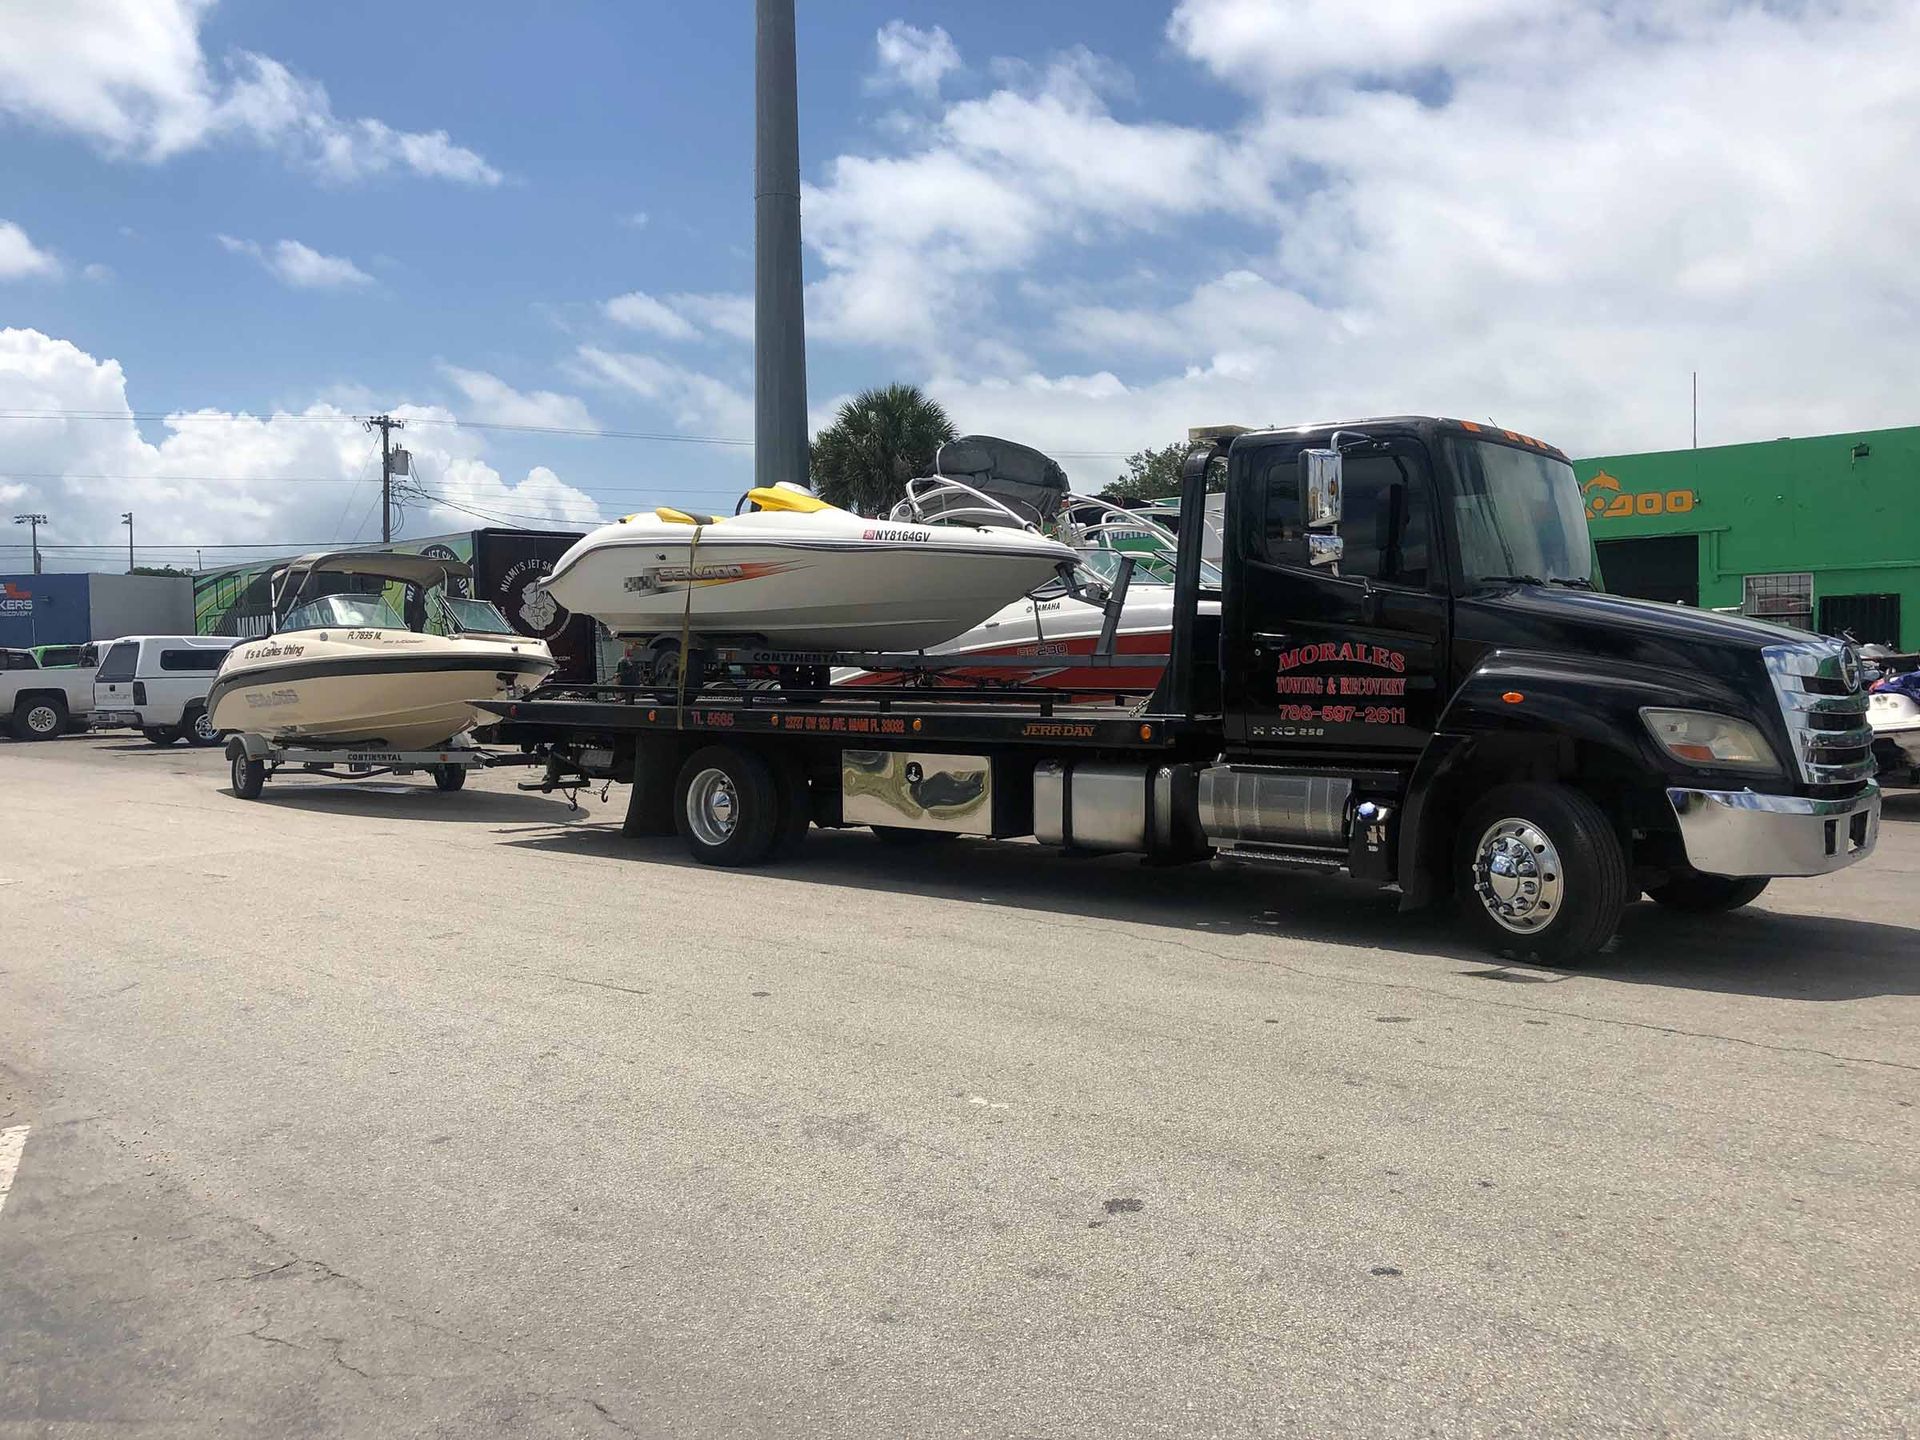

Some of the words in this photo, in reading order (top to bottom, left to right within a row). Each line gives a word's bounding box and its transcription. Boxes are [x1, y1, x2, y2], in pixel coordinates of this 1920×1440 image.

[876, 530, 931, 542] NY8164GV
[527, 559, 540, 569] JET
[542, 561, 553, 572] SK
[1034, 602, 1061, 612] AMAHA
[283, 644, 305, 657] thing
[1277, 642, 1405, 673] MORALES
[1276, 676, 1323, 694] TOWING
[1326, 677, 1336, 695] &
[1340, 677, 1407, 696] RECOVERY
[1279, 704, 1405, 724] 786-597-2611
